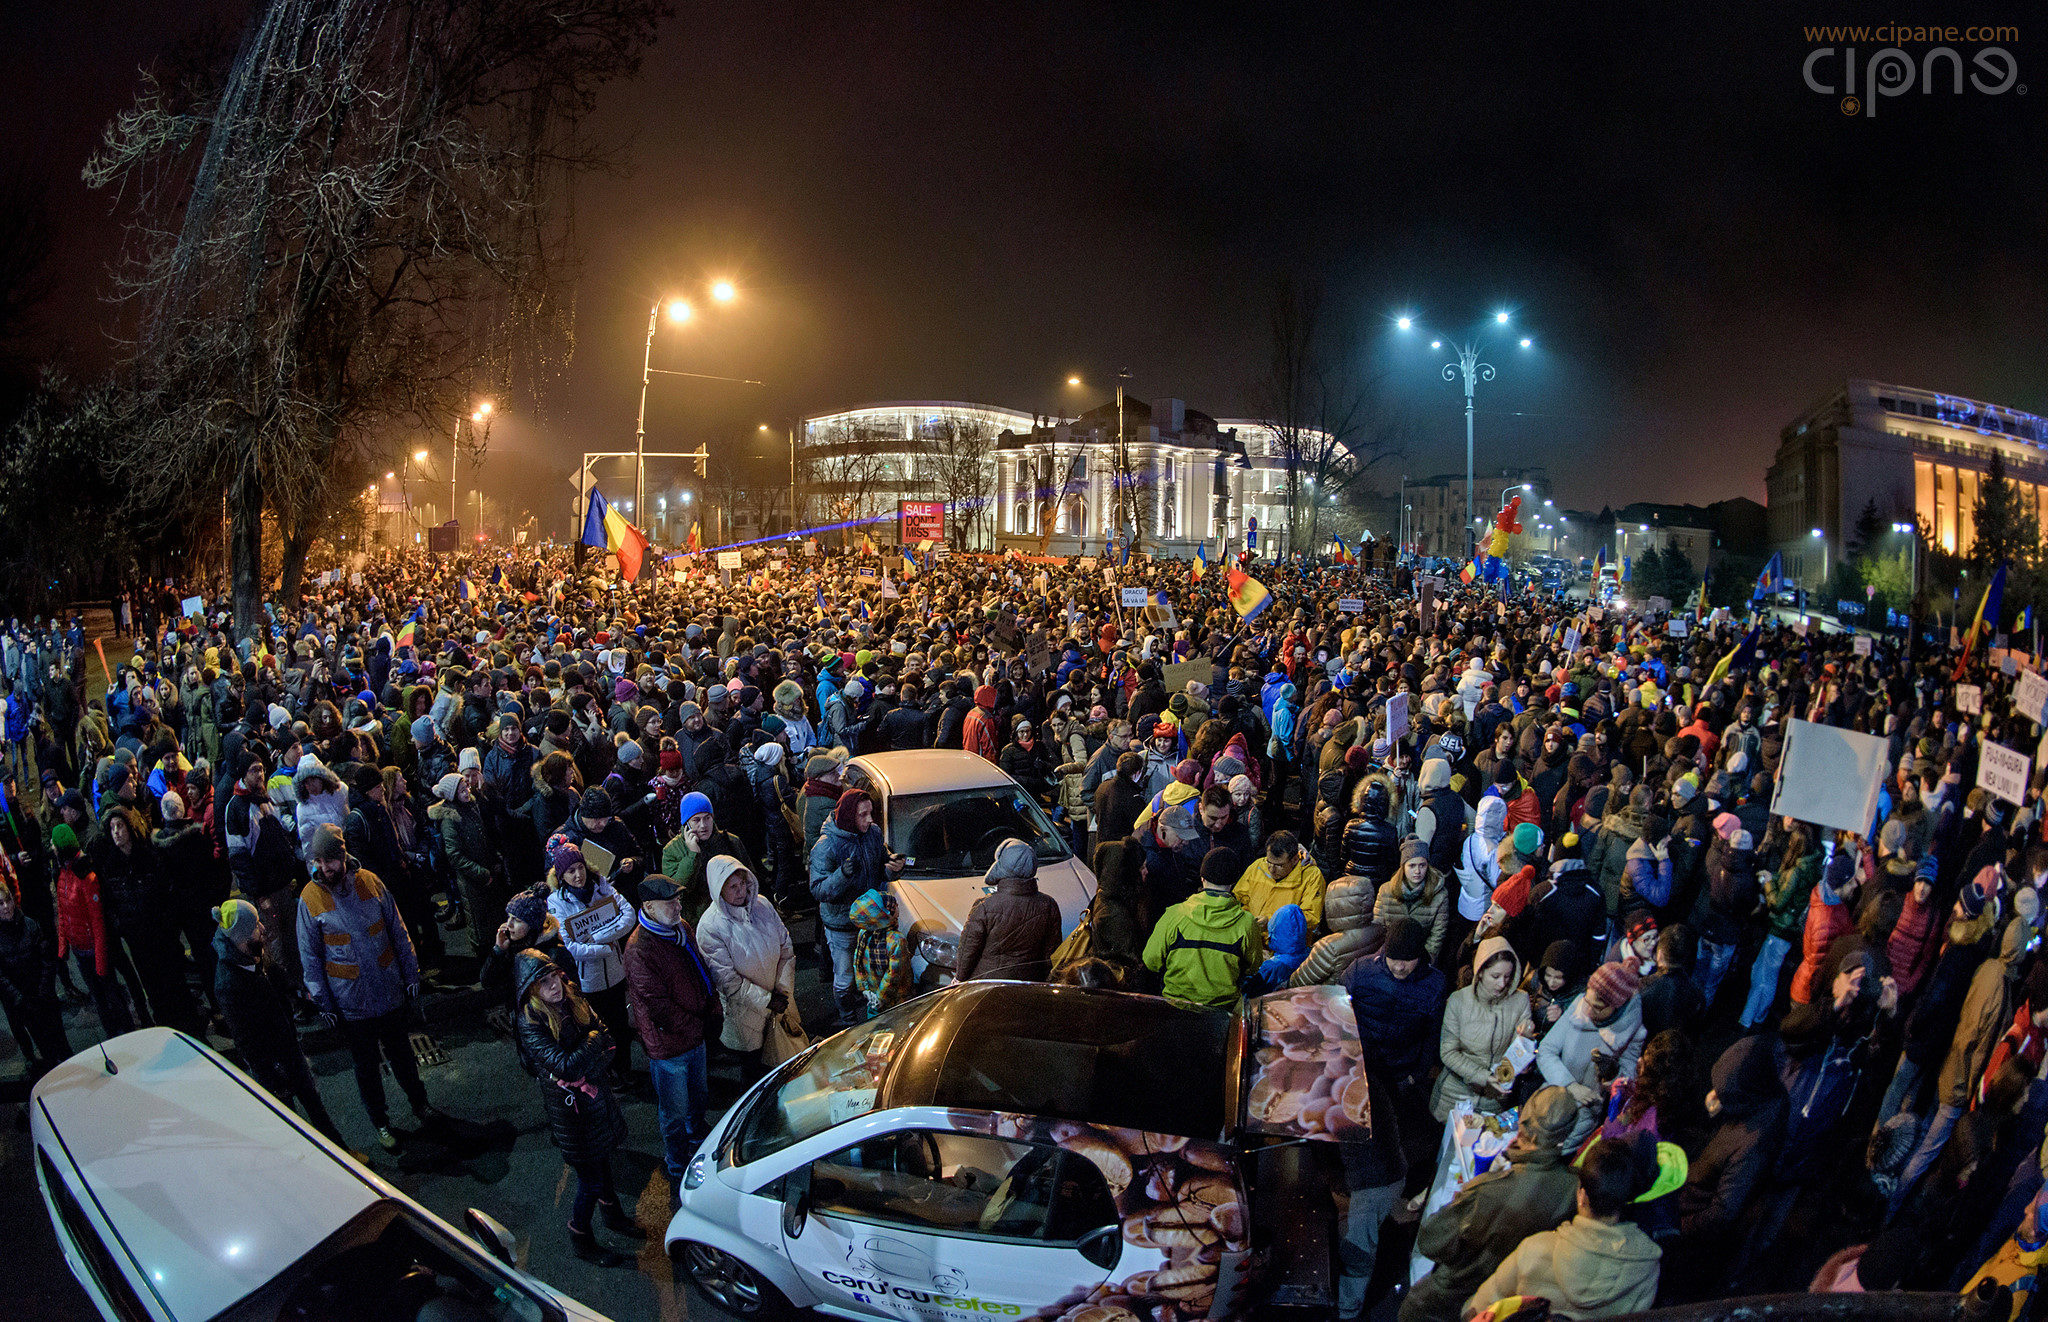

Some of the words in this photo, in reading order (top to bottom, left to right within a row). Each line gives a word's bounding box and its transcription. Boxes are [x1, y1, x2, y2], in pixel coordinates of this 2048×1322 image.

[905, 504, 932, 516] SALE
[905, 515, 936, 527] DON'T
[905, 527, 929, 538] MISS
[881, 1300, 967, 1320] carucucafea
